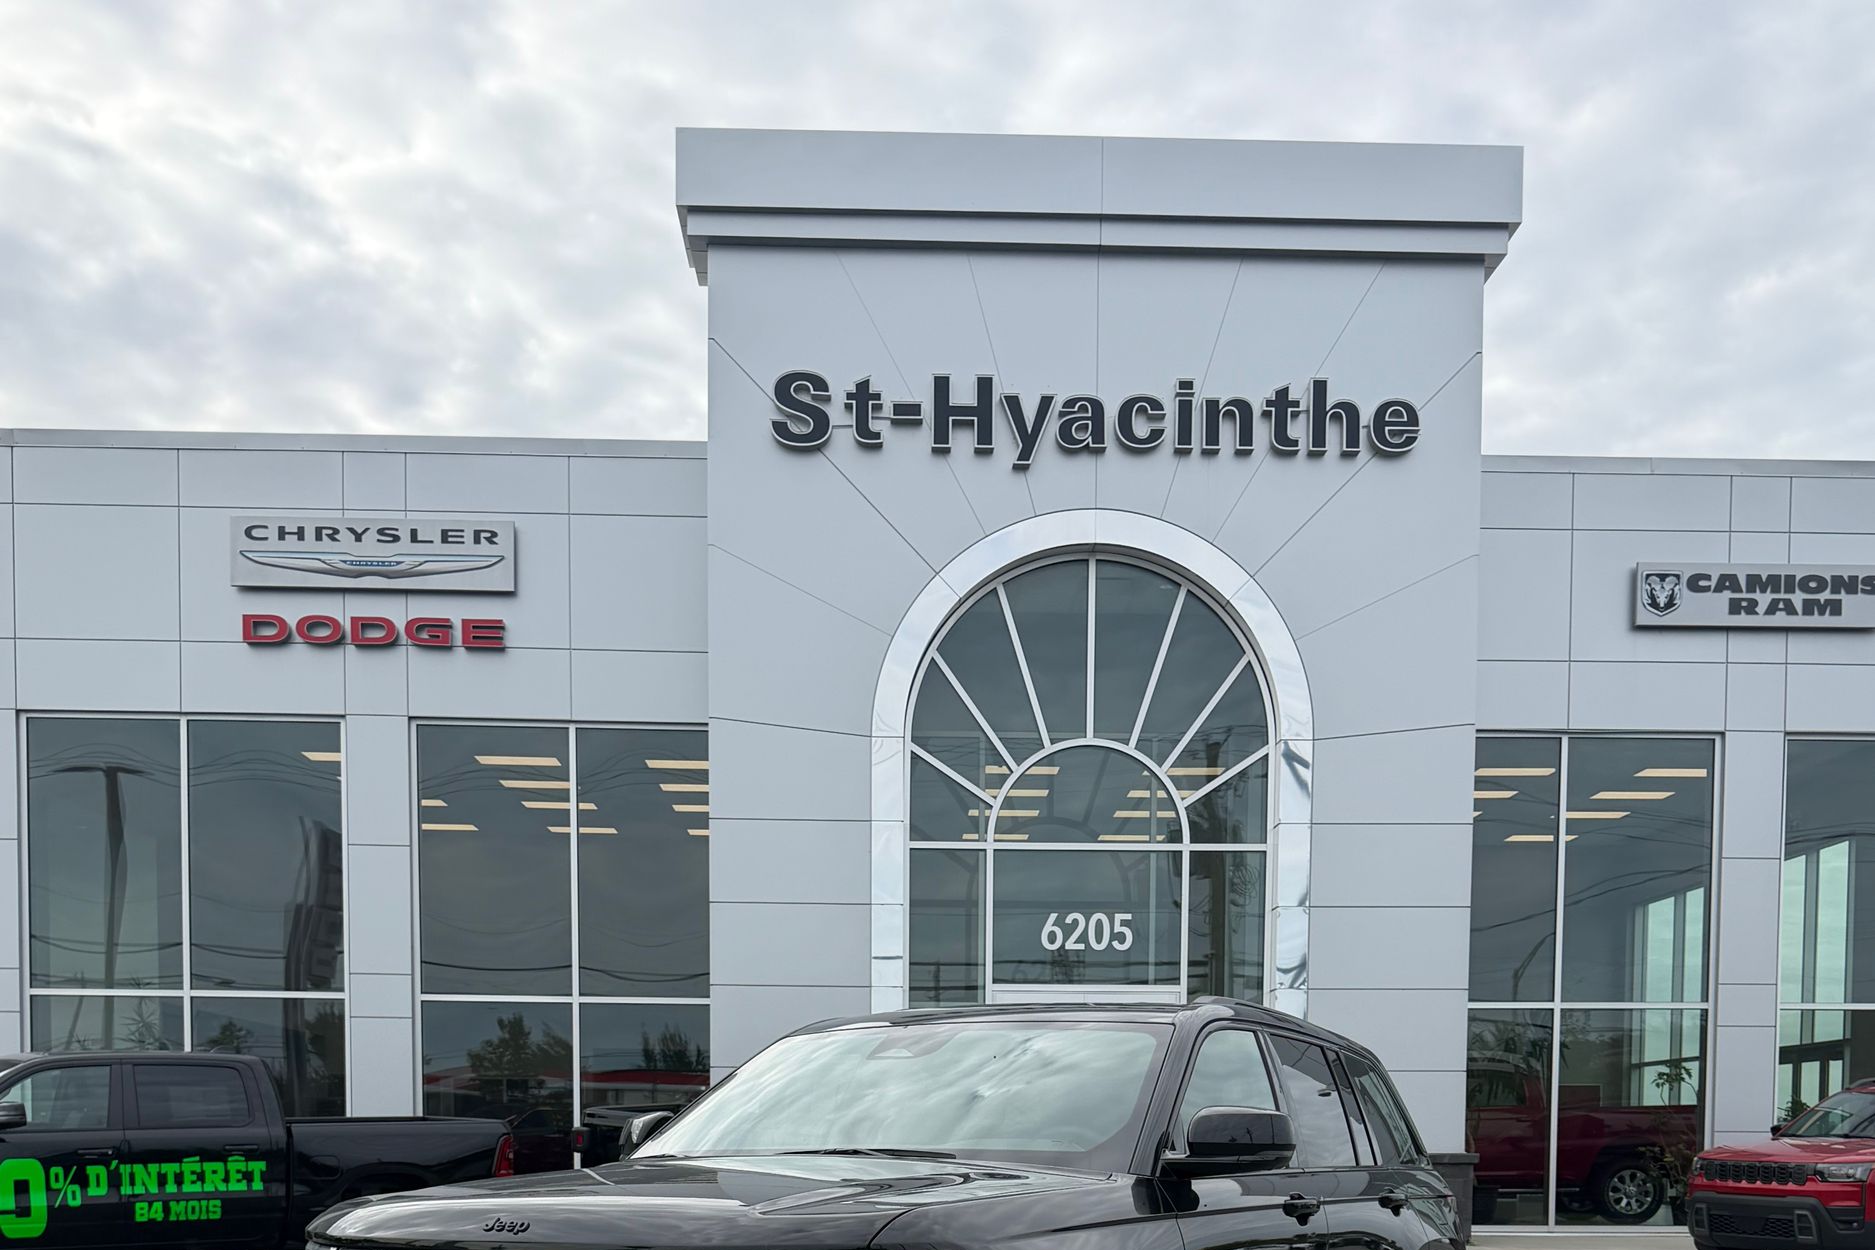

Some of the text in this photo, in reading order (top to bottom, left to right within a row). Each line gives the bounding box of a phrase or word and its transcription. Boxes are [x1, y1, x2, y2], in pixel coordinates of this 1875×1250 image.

[770, 369, 1421, 469] St-Hyacinthe
[243, 523, 500, 546] CHRYSLER
[1686, 573, 1875, 595] CAMIONS
[1727, 597, 1843, 616] RAM
[242, 614, 506, 648] DODGE
[1040, 912, 1134, 951] 6205
[134, 1199, 222, 1223] 84 MOIS
[482, 1217, 531, 1236] Jeep
